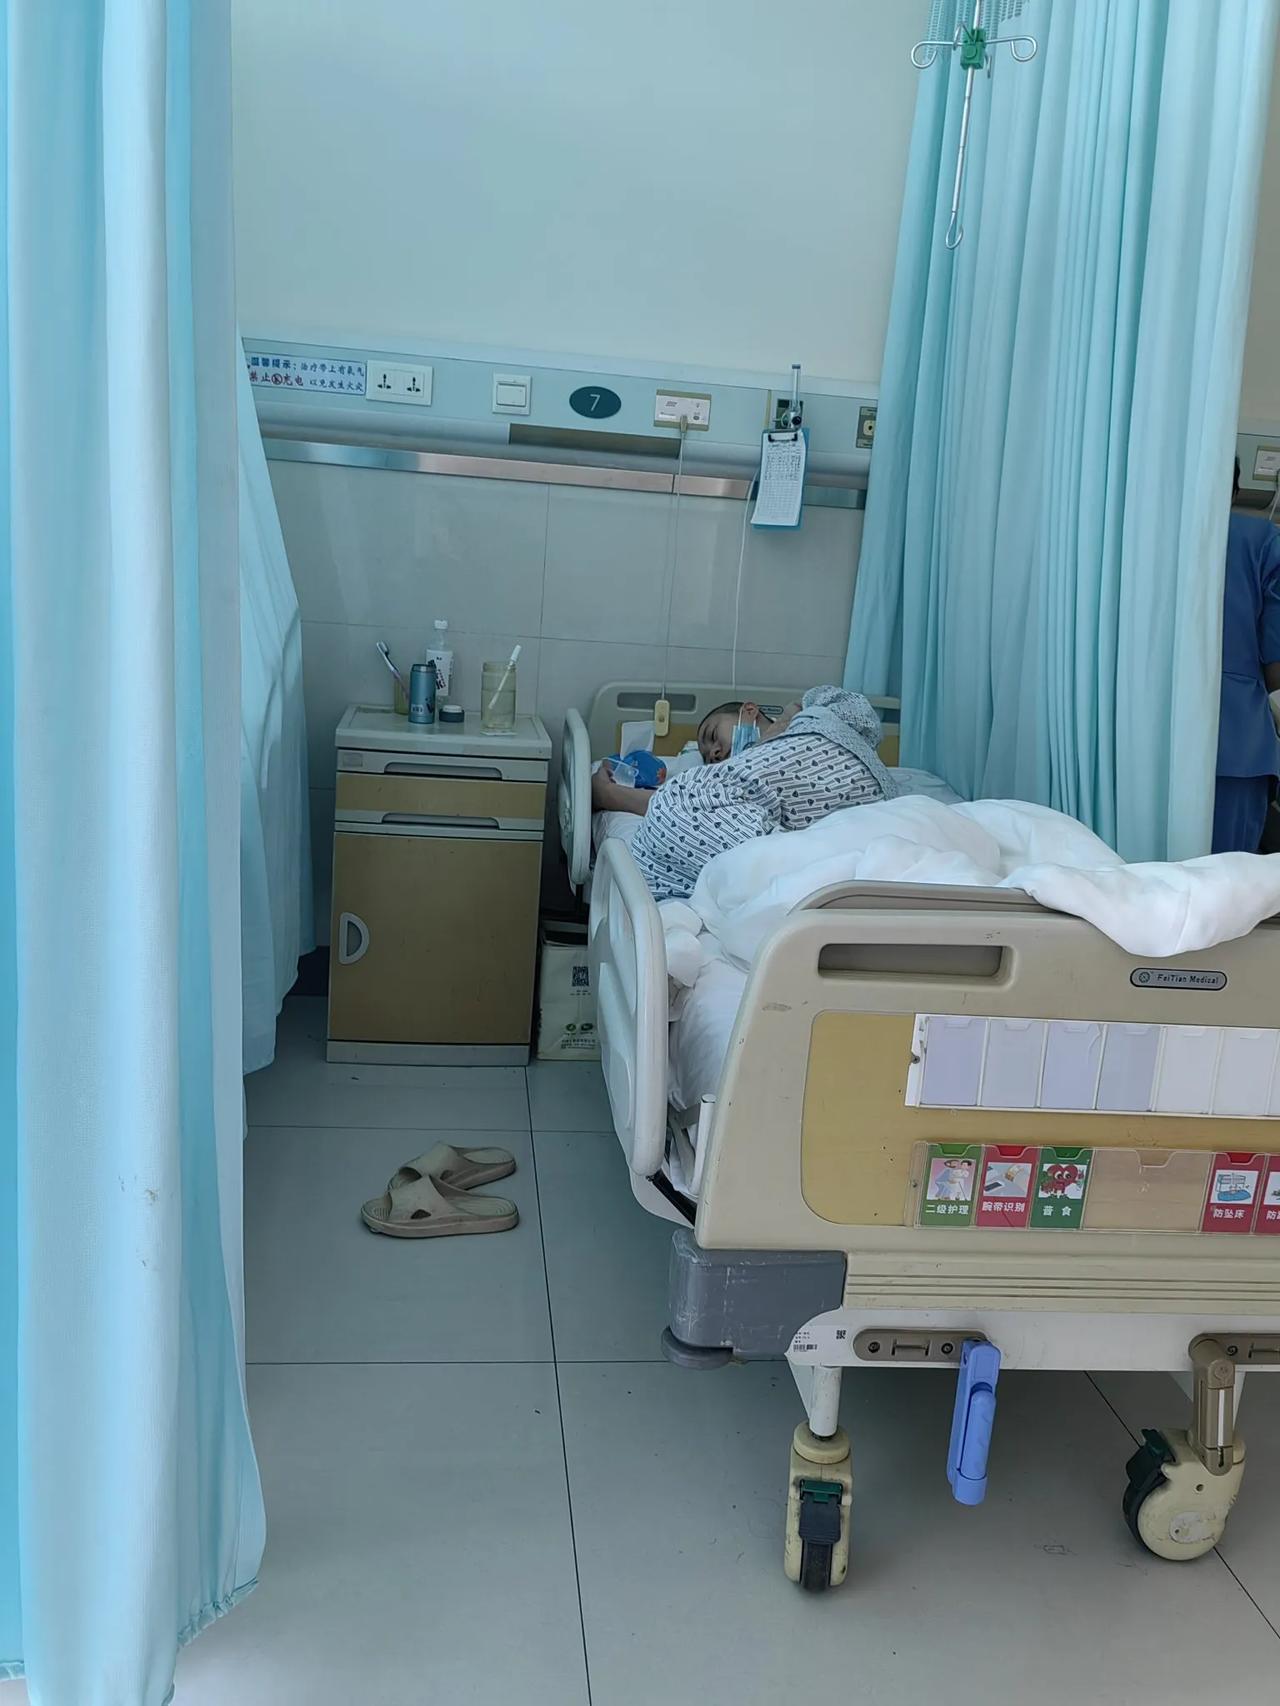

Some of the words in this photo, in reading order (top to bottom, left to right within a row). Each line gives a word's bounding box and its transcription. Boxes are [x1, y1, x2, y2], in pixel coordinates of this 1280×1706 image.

[589, 393, 601, 412] 7
[1157, 974, 1187, 983] FeiTian
[1190, 975, 1219, 985] Medical
[925, 1204, 969, 1215] 二级护理
[982, 1201, 1025, 1213] 腕带识别
[1213, 1208, 1245, 1219] 防坠床
